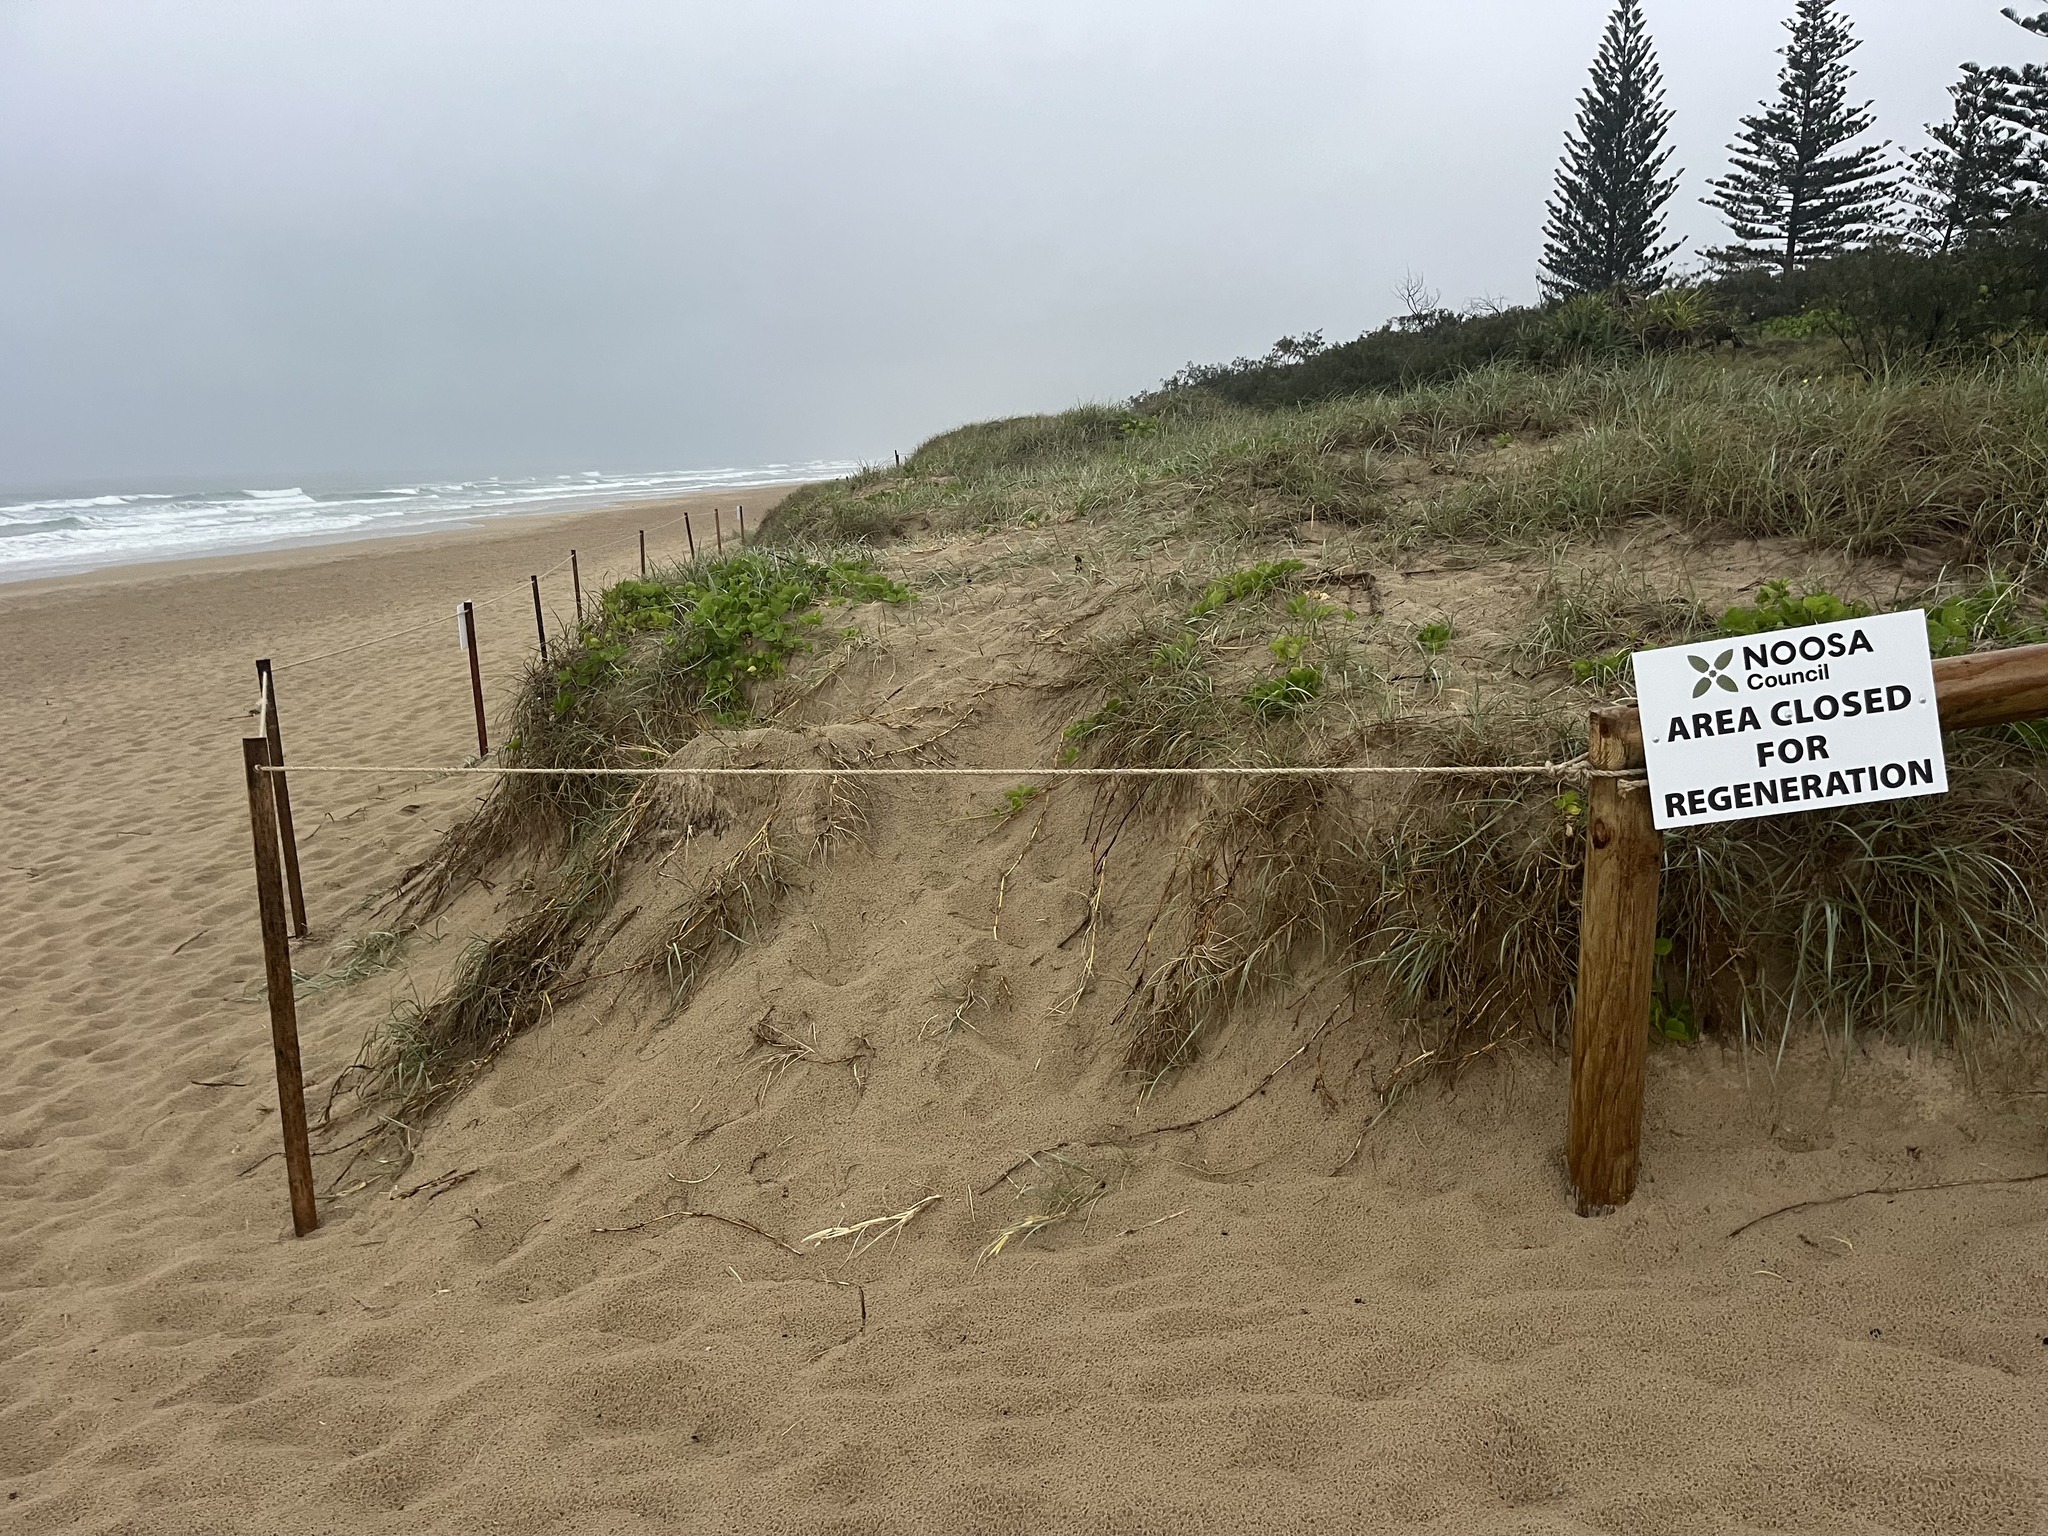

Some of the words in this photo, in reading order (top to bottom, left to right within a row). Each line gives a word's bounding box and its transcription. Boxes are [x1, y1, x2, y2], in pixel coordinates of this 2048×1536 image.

[1743, 629, 1874, 670] NOOSA
[1747, 664, 1829, 690] Council
[1667, 706, 1761, 742] AREA
[1770, 685, 1912, 726] CLOSED
[1756, 735, 1829, 767] FOR
[1665, 759, 1934, 818] REGENERATION
